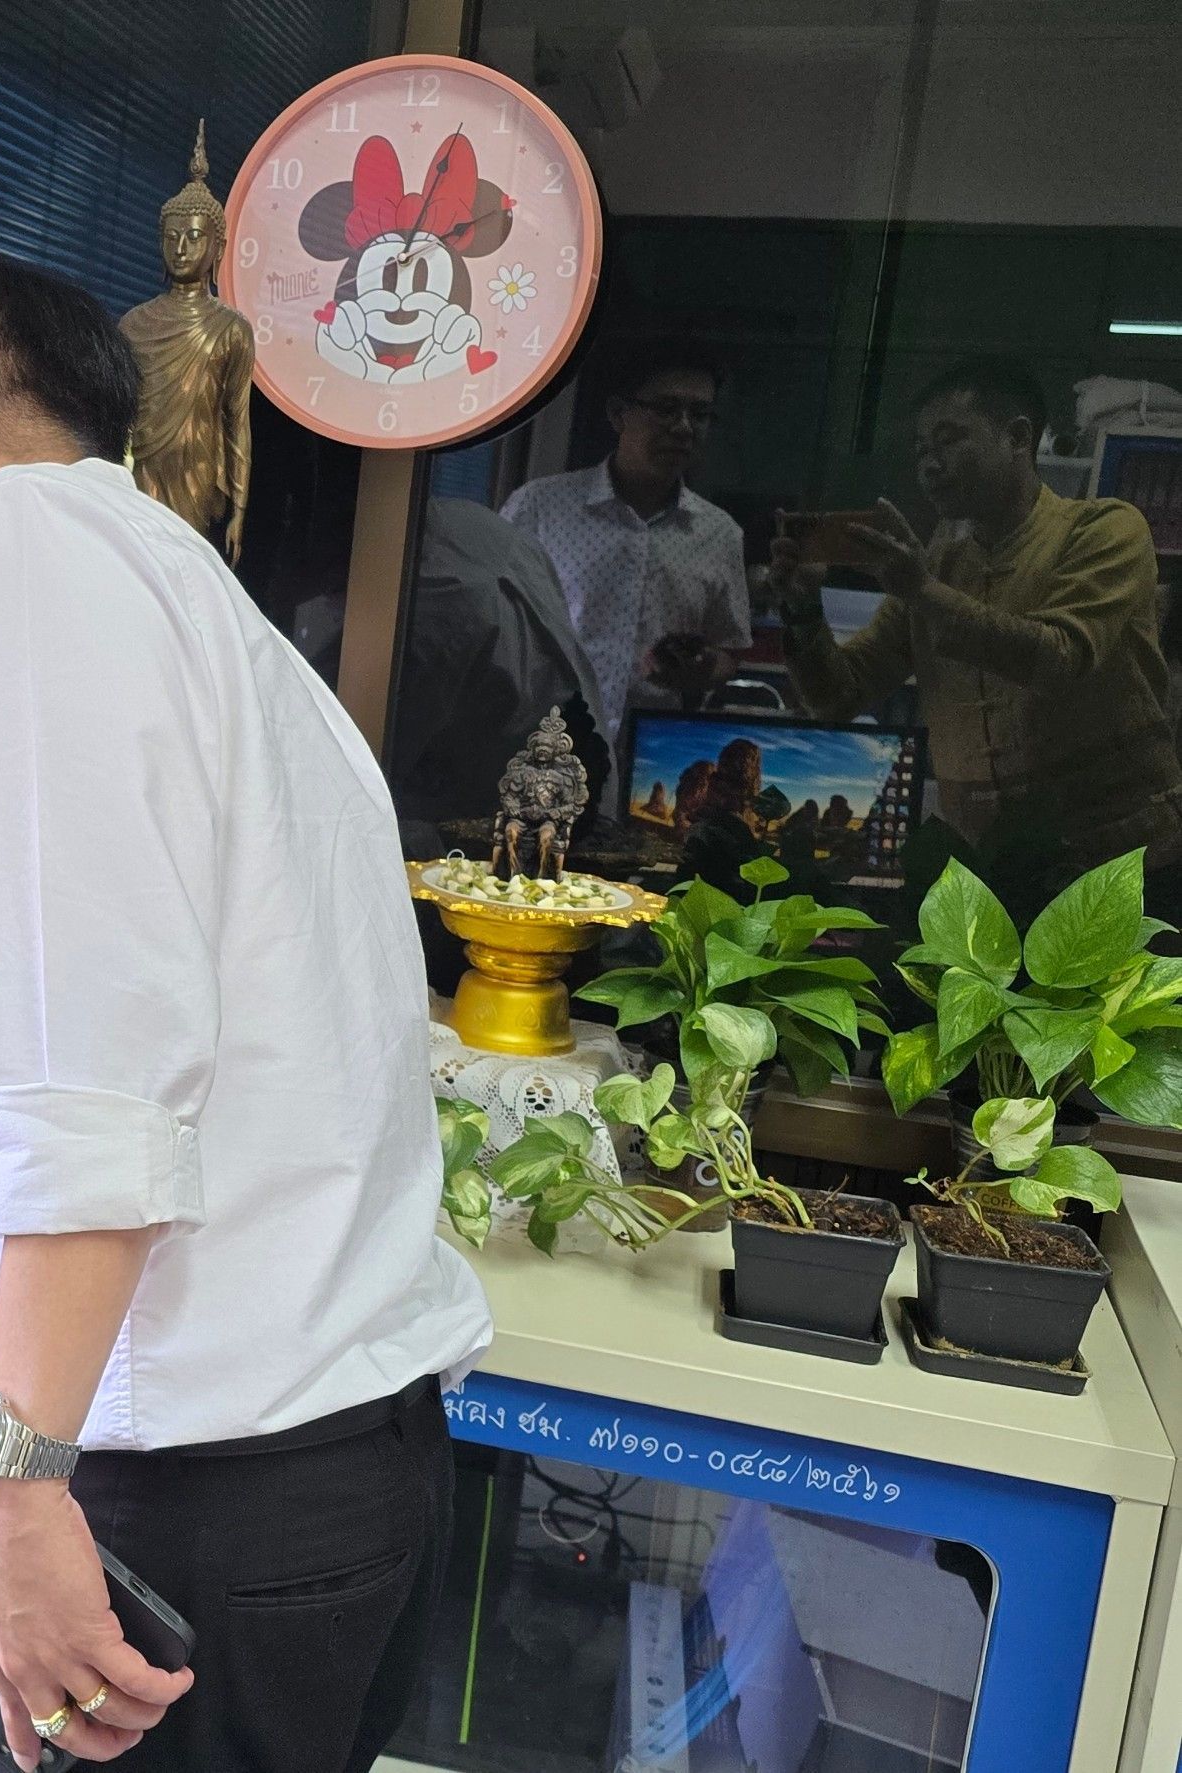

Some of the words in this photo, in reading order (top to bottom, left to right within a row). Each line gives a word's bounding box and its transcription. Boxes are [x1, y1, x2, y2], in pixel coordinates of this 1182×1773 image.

[401, 74, 441, 107] 12
[325, 102, 360, 133] 11
[493, 103, 511, 134] 1
[267, 158, 304, 190] 10
[542, 162, 564, 194] 2
[239, 238, 260, 268] 9
[556, 246, 578, 277] 3
[254, 315, 274, 345] 8
[522, 325, 543, 356] 4
[306, 376, 325, 406] 7
[459, 383, 481, 414] 5
[378, 401, 398, 432] 6
[518, 1402, 571, 1441] ชม.
